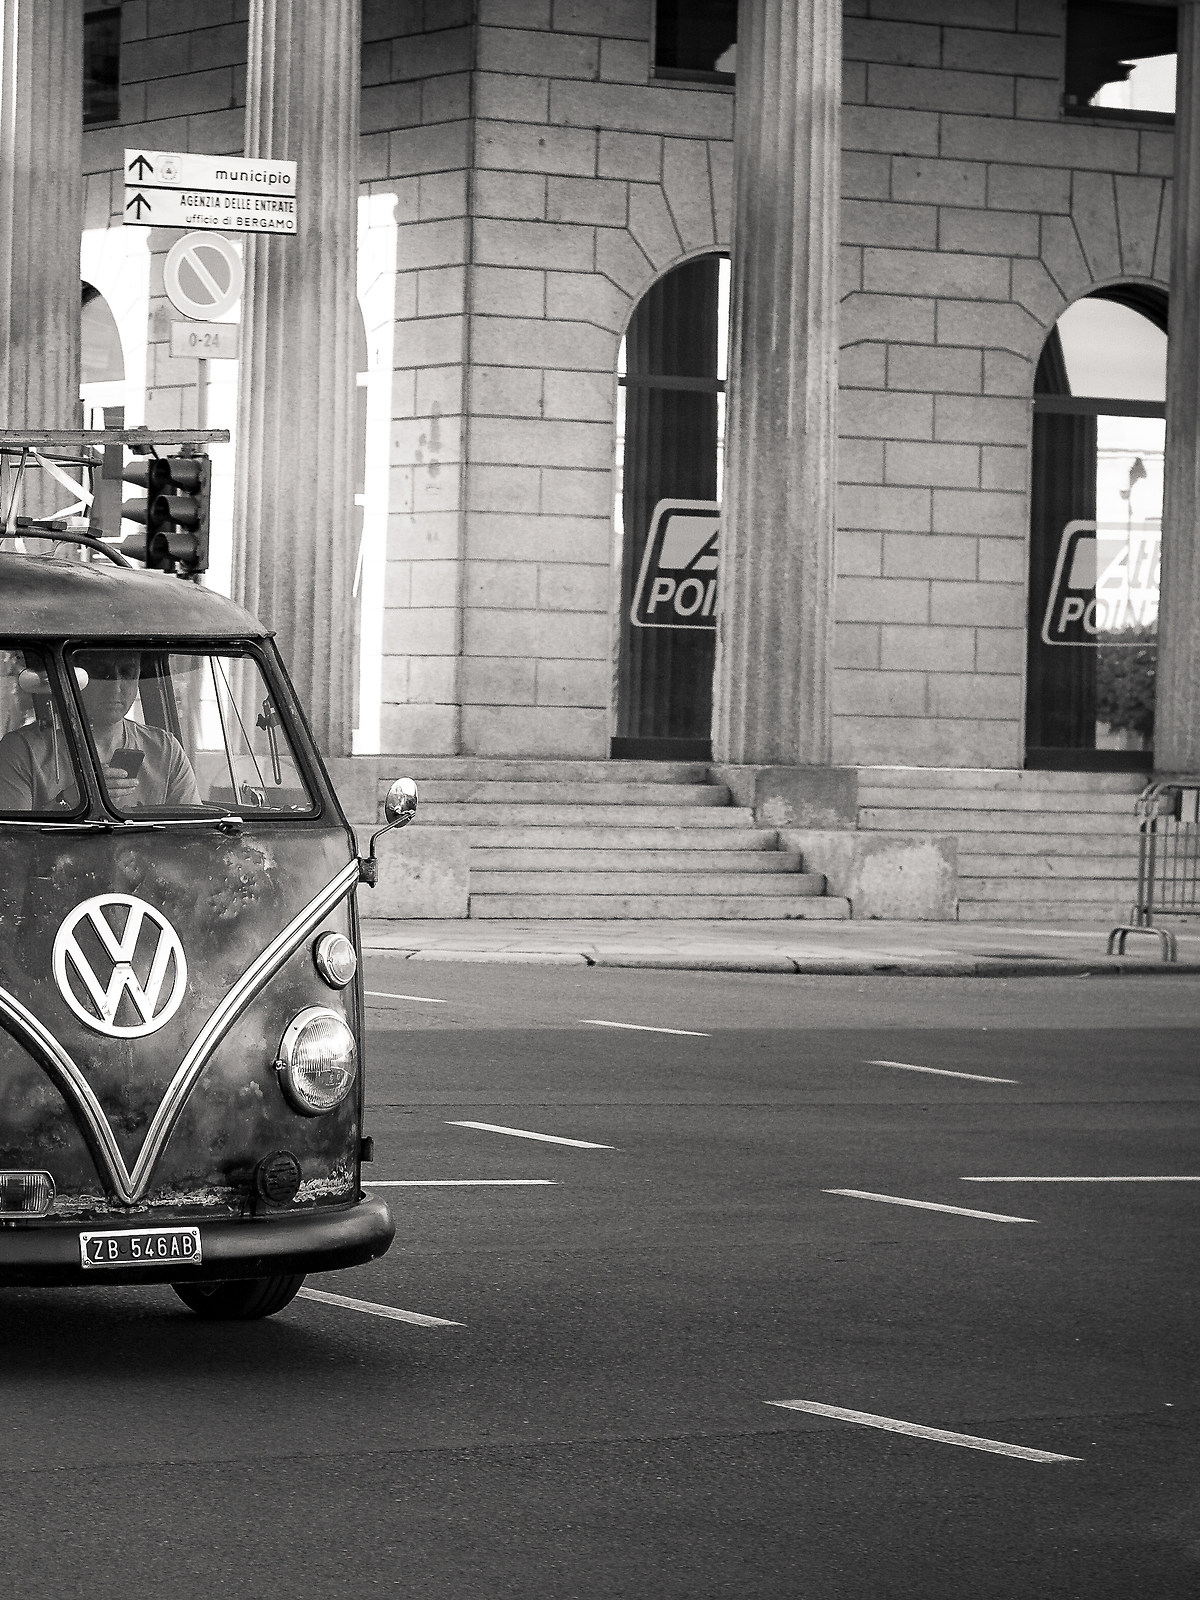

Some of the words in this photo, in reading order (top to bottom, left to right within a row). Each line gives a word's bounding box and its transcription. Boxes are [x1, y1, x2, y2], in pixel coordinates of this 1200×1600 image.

[215, 169, 291, 186] municipio
[180, 194, 220, 208] AGENZIA
[224, 197, 251, 210] DELLE
[255, 199, 294, 213] ENTRATE
[186, 214, 218, 225] ufficio
[222, 216, 232, 225] di
[236, 216, 294, 229] BERGAMO
[189, 332, 220, 348] 0-24
[646, 577, 718, 616] POI
[53, 893, 187, 1039] VW
[93, 1239, 119, 1260] ZB
[131, 1235, 193, 1258] 546AB
